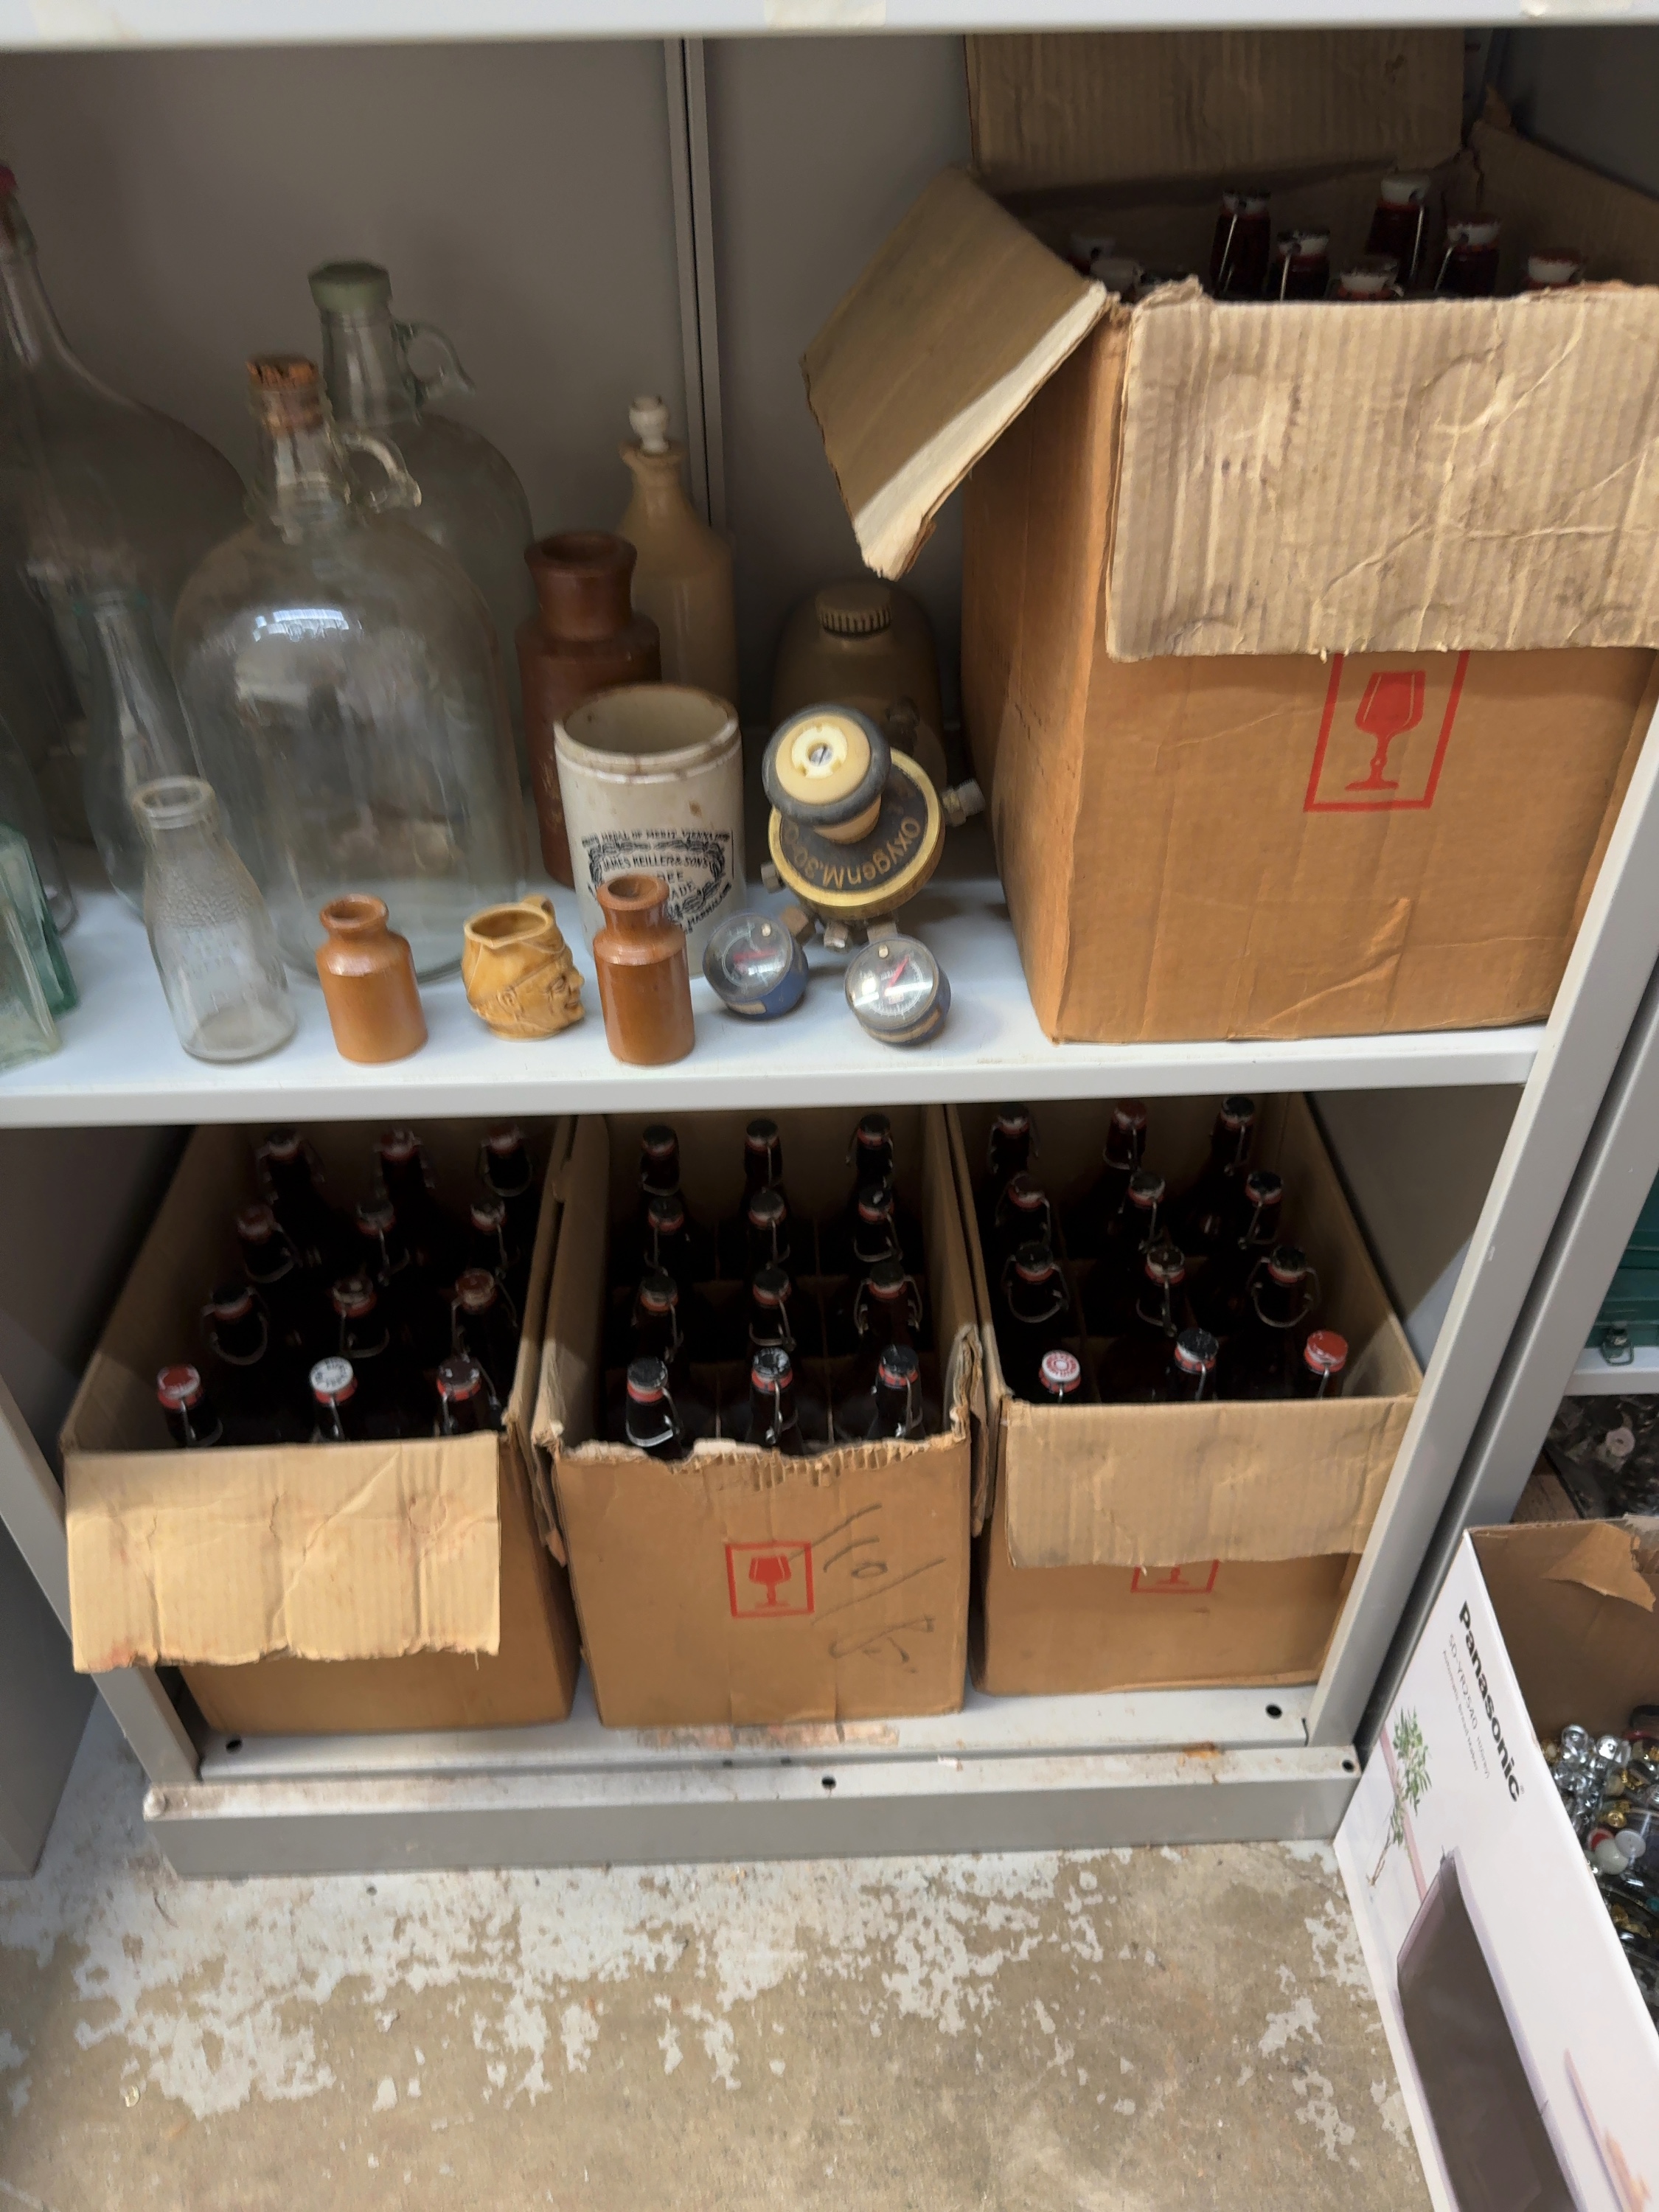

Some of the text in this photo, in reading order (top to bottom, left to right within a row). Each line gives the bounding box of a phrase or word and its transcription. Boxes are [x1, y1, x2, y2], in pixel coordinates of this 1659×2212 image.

[602, 855, 631, 873] JAMES
[1448, 1633, 1478, 1731] SD-YR2540
[1458, 1600, 1520, 1802] Panasonic
[1458, 1703, 1470, 1736] Bread
[1467, 1736, 1478, 1771] Maker
